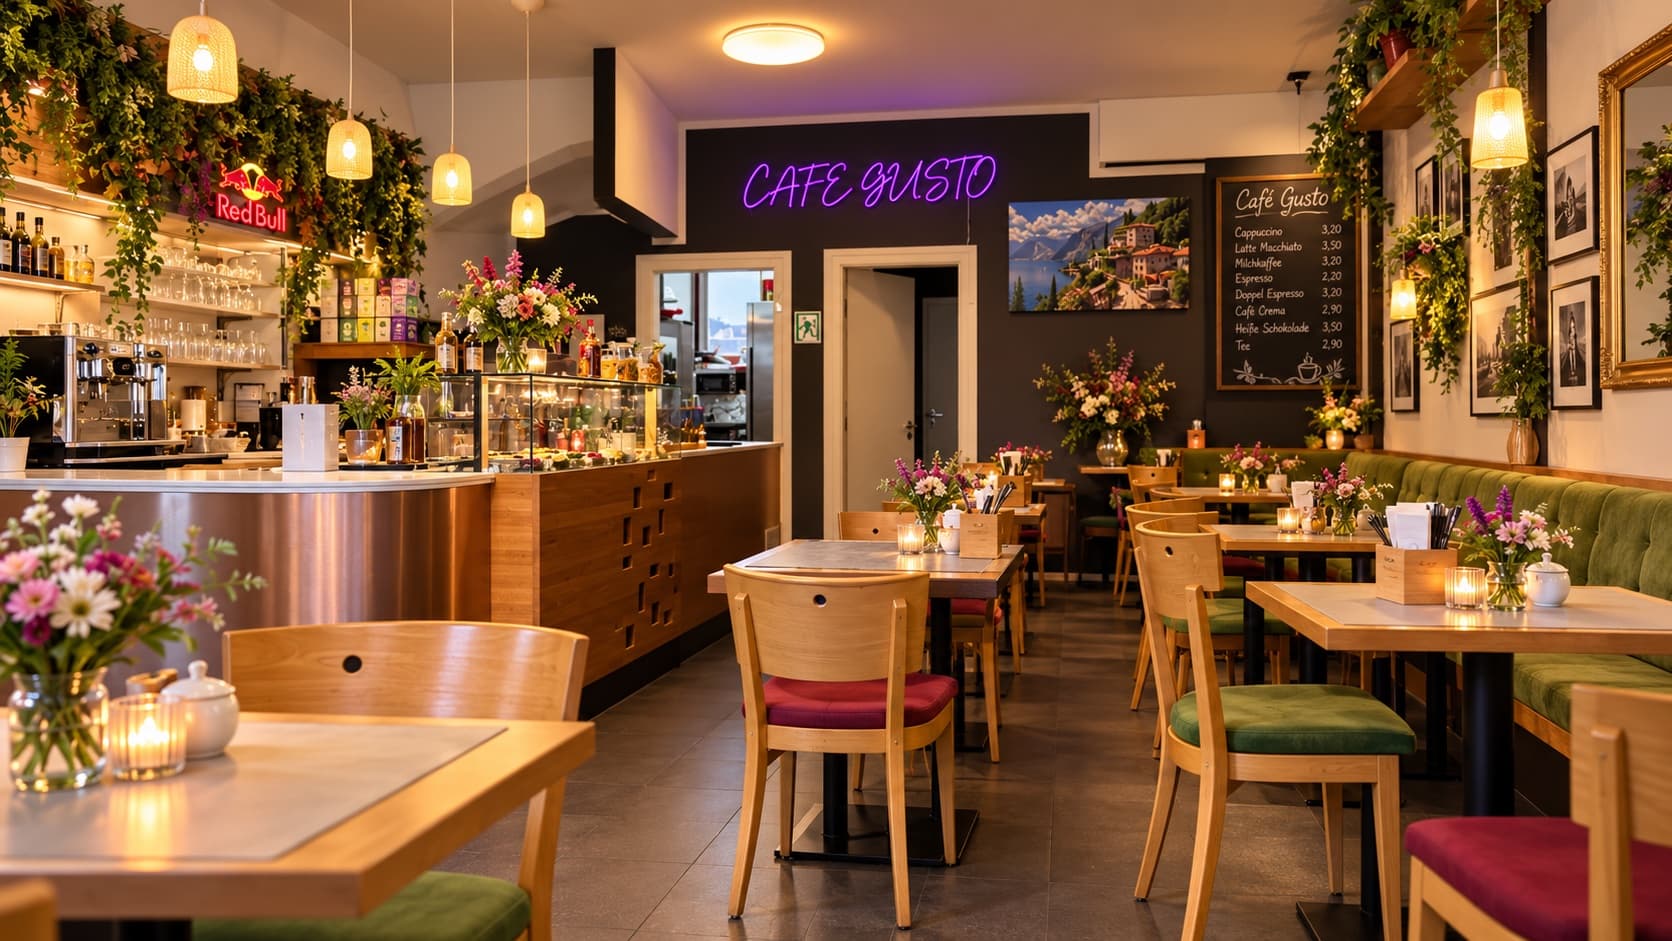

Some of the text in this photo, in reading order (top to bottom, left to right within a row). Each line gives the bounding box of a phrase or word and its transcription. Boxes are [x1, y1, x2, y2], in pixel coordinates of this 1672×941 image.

[743, 154, 997, 209] CAFE GUSTO
[1235, 187, 1329, 217] Café Gusto
[217, 193, 286, 232] Red Bull
[1235, 223, 1342, 240] Cappuccino 3,20
[1235, 240, 1342, 254] Latte Macchiato 3,50
[1235, 256, 1342, 272] Milchkaffee 3,20
[1235, 271, 1342, 286] Espresso 2,20
[1235, 287, 1342, 303] Doppel Espresso 3,20
[1235, 304, 1342, 320] Café Crema 2,90
[1235, 321, 1343, 337] Heiße Schokolade 3,50
[1235, 338, 1343, 352] Tee 2,90
